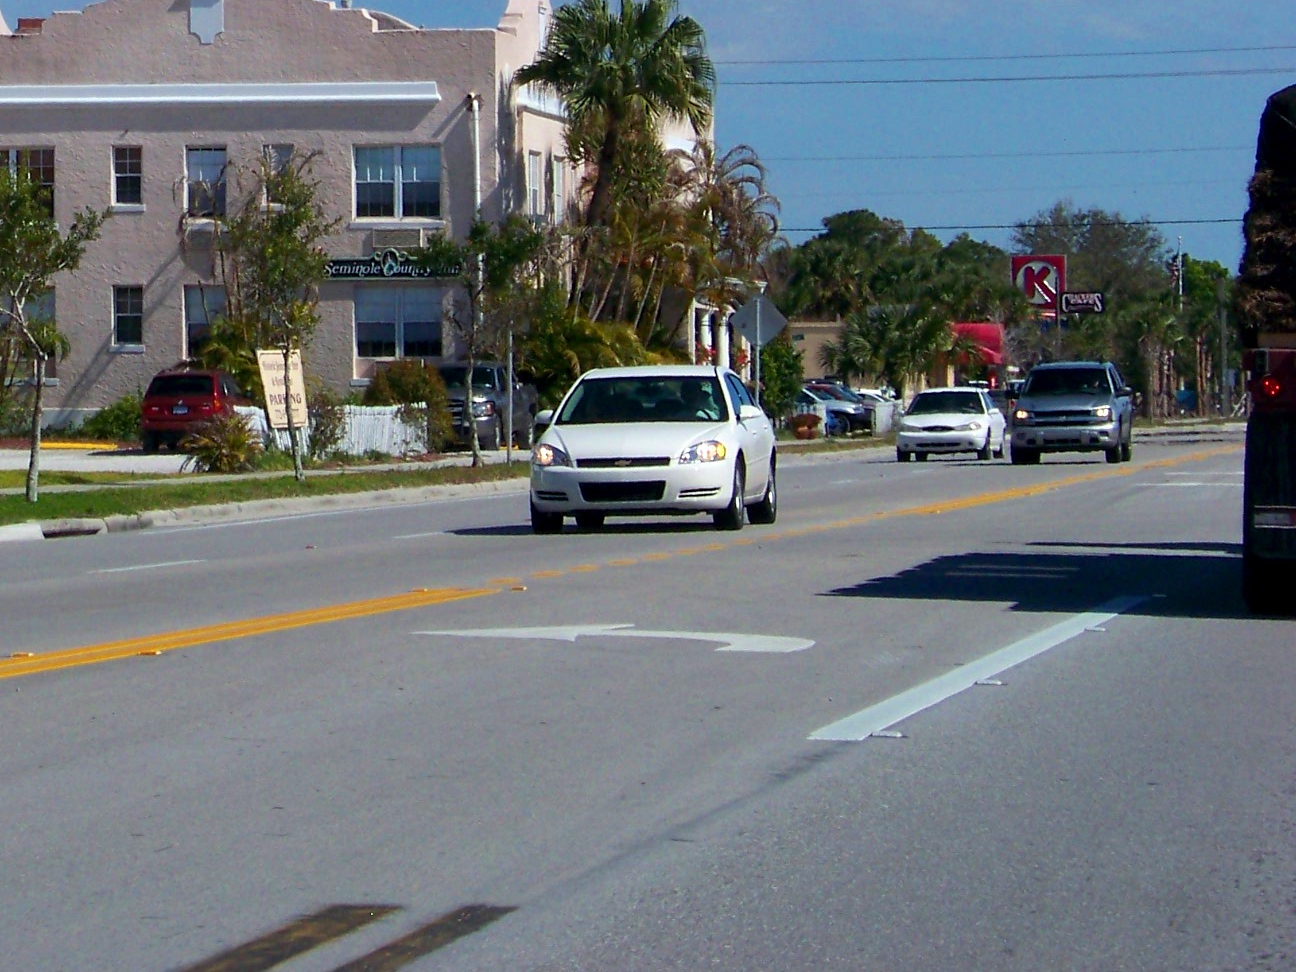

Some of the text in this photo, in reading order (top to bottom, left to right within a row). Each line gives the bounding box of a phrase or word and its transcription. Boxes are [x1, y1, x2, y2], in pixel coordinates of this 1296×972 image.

[324, 261, 381, 277] Seminole
[1024, 266, 1057, 304] K
[269, 393, 302, 406] PARKNG
